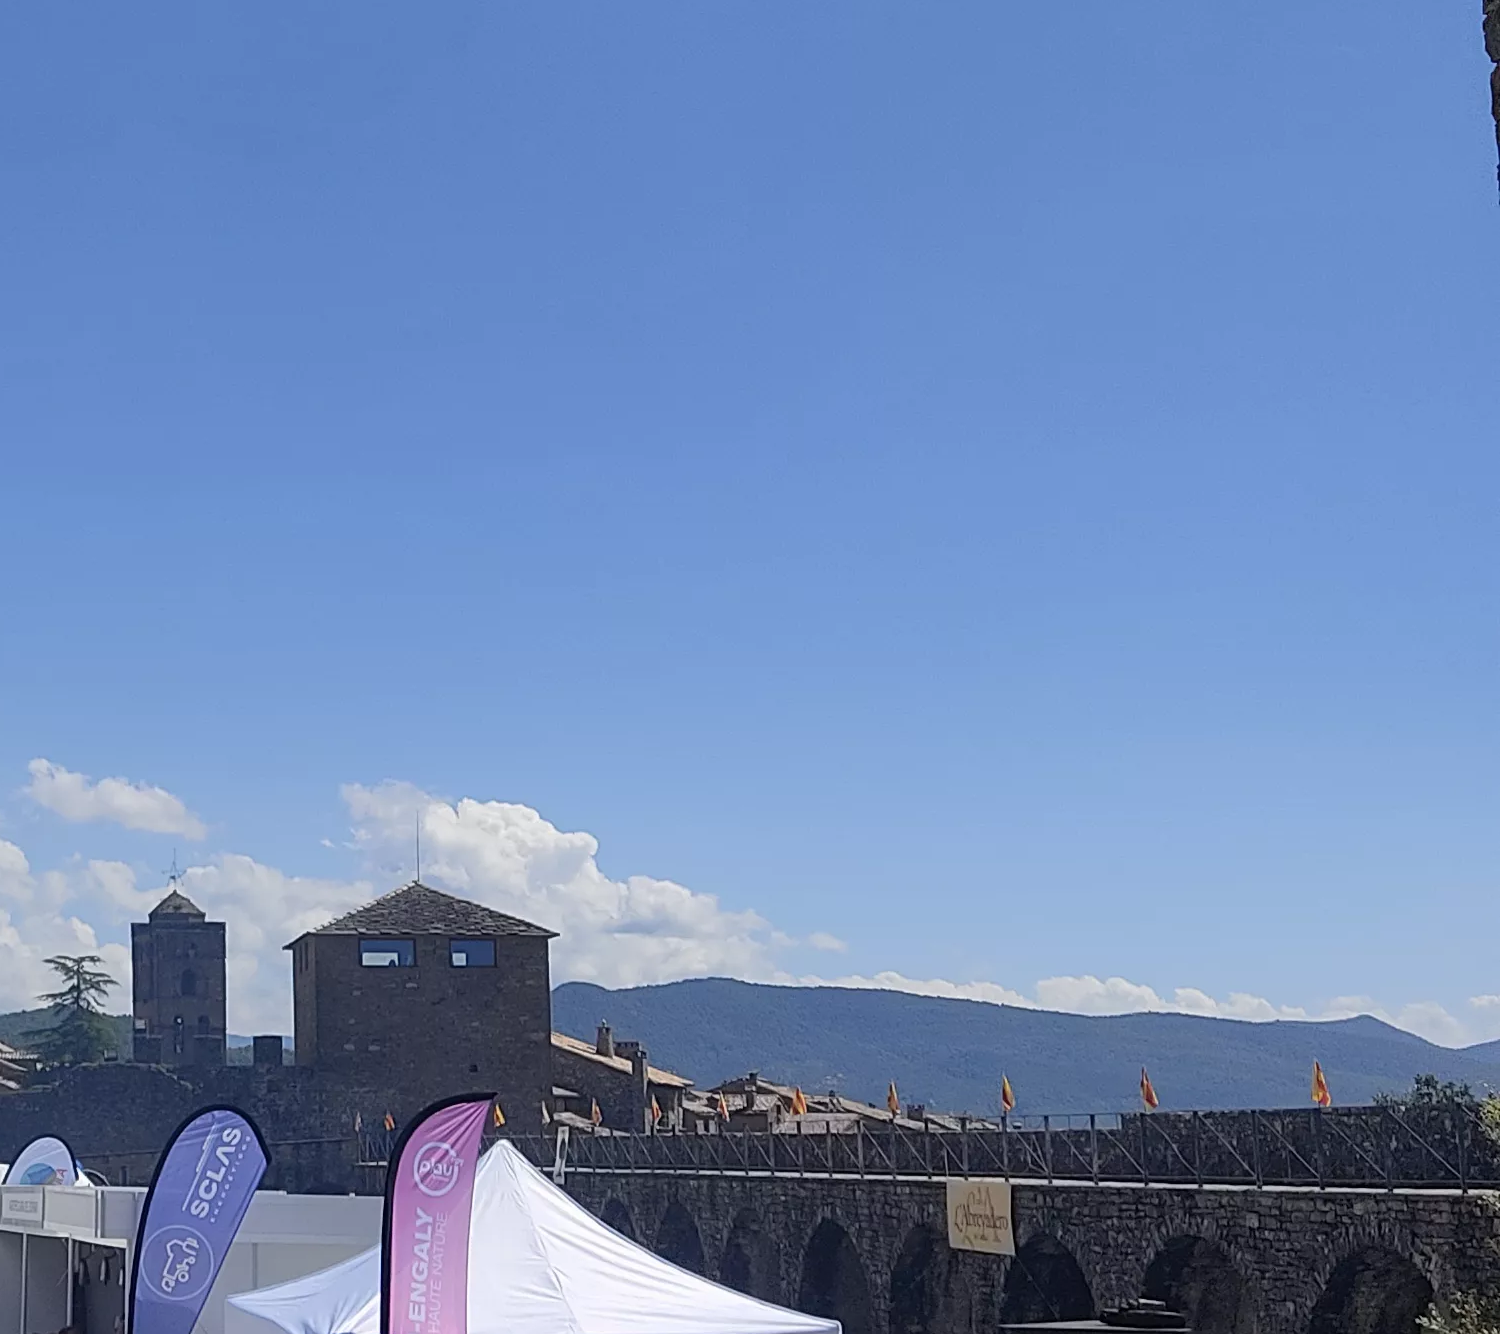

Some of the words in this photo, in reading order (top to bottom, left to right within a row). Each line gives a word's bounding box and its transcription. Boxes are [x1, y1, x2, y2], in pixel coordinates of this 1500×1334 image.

[190, 1127, 242, 1218] SCLAS
[432, 1212, 449, 1275] NATURE
[427, 1279, 442, 1333] HAUTE
